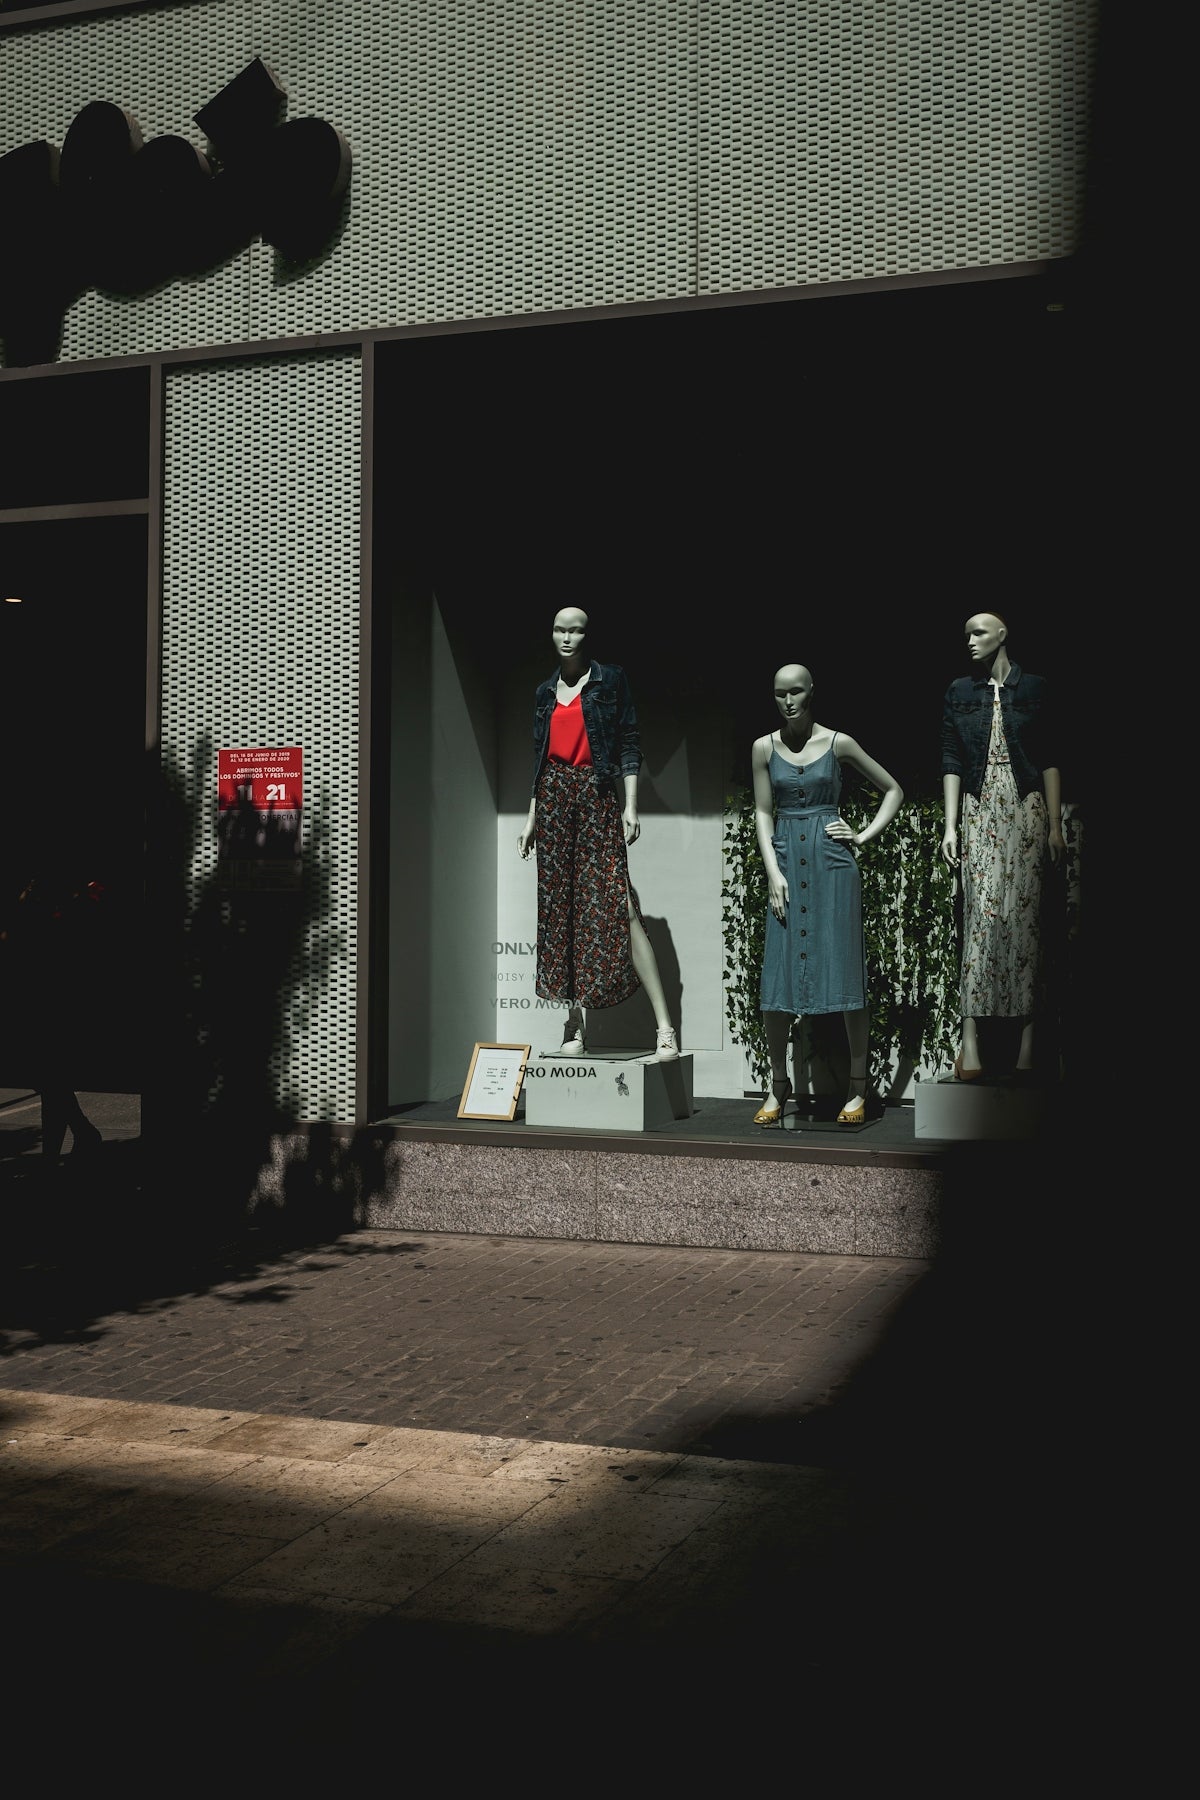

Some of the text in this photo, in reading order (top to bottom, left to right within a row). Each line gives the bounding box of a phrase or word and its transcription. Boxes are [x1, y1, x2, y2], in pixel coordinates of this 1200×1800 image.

[237, 784, 252, 800] 11
[266, 784, 286, 800] 21
[491, 942, 538, 955] ONLY
[489, 998, 583, 1009] VERO MODA
[550, 1067, 597, 1078] MODA
